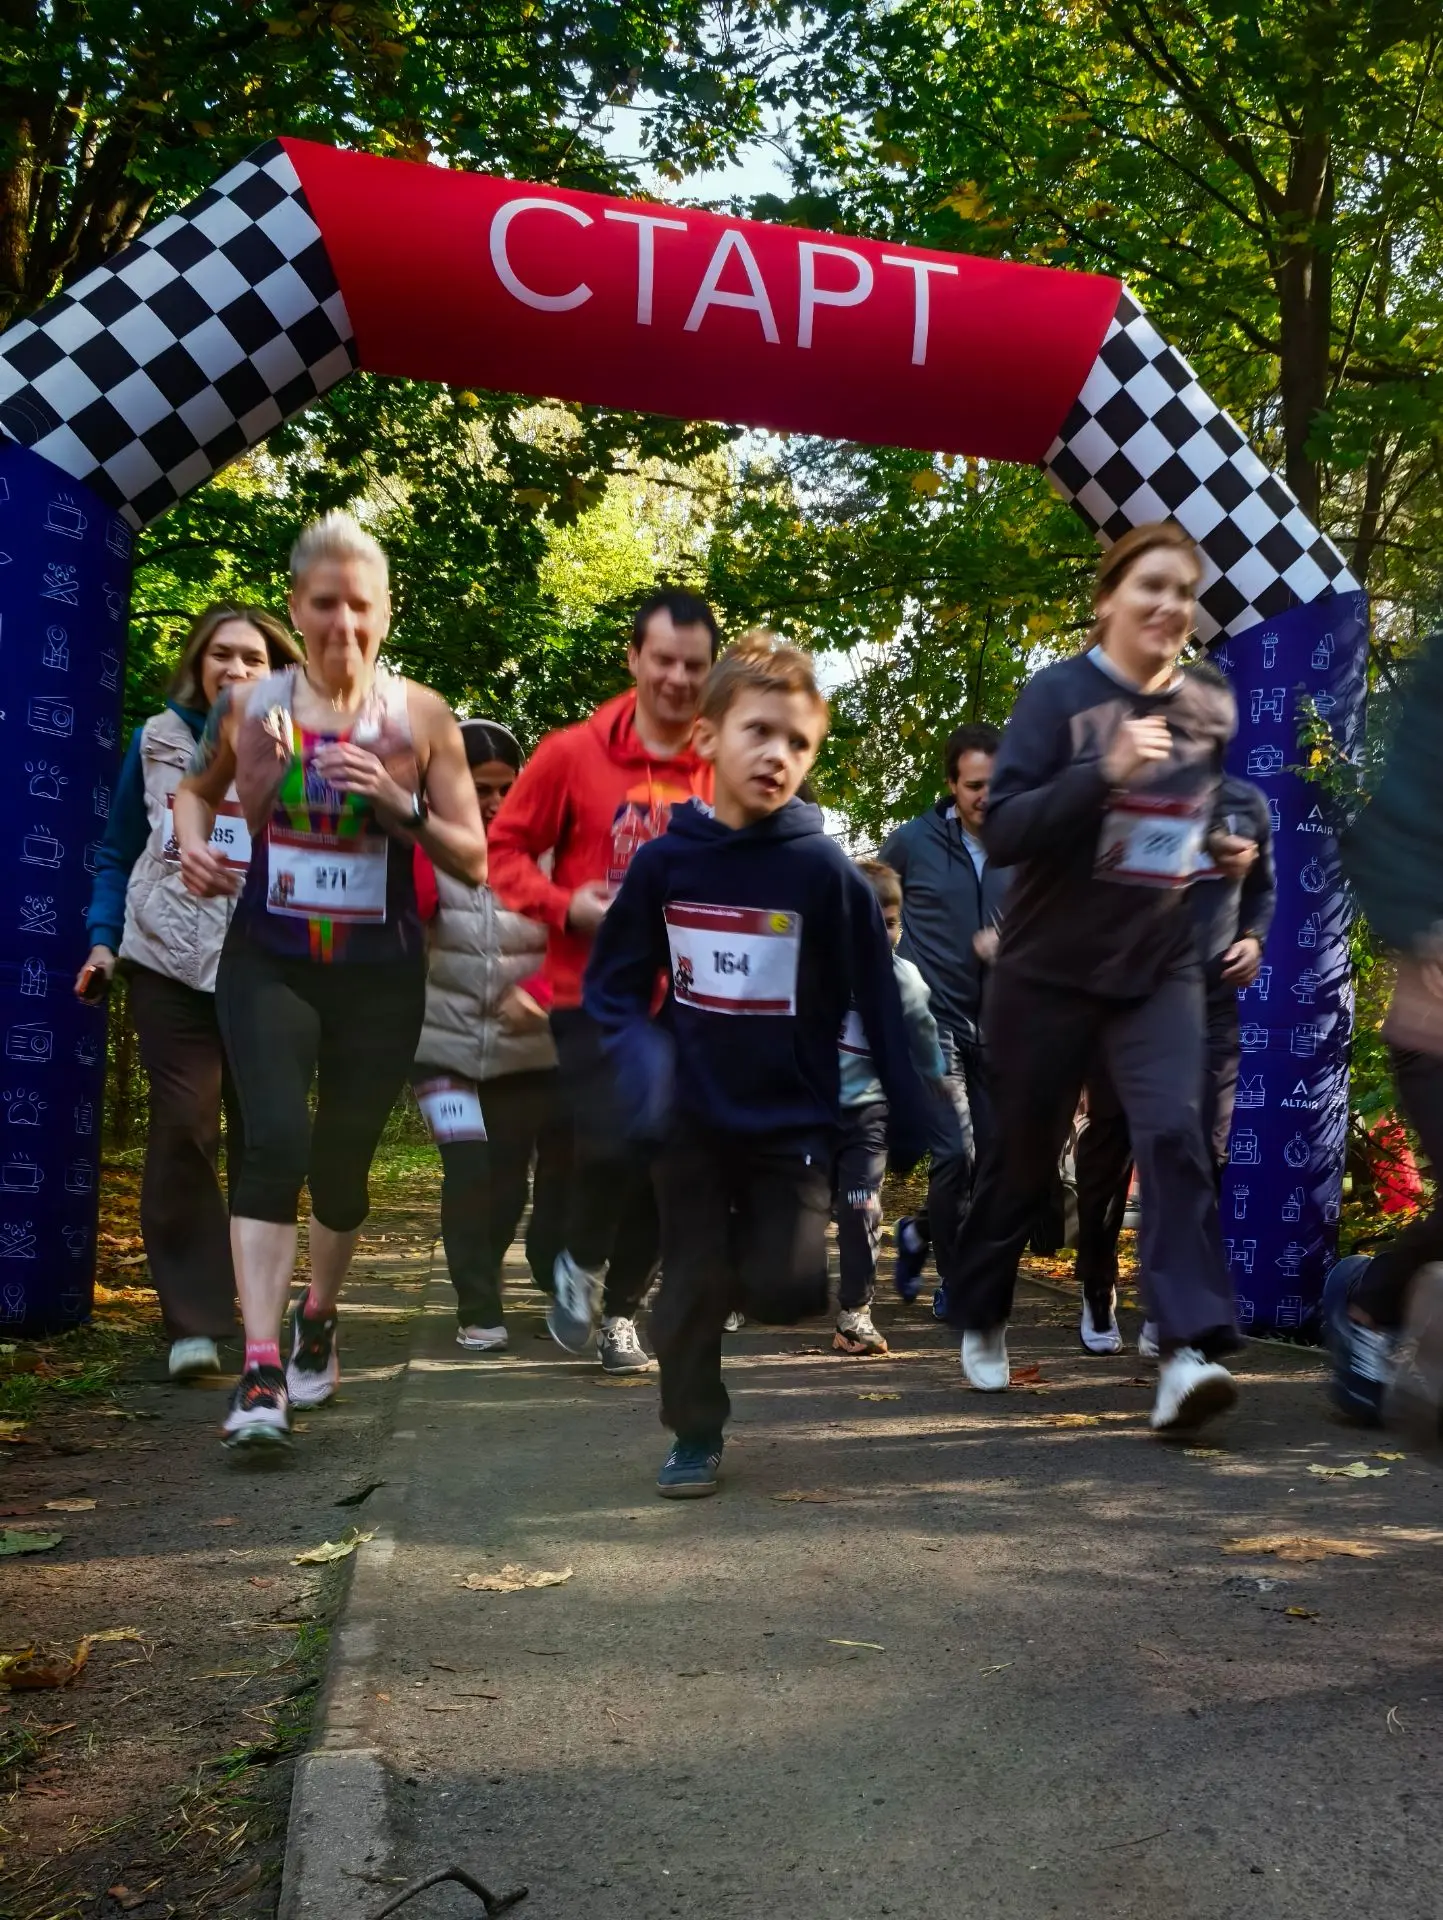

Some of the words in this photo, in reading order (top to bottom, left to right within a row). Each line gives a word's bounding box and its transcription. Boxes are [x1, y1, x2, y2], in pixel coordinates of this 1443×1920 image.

[489, 197, 959, 366] СТАРТ
[1296, 822, 1334, 836] ALTAIR
[713, 950, 750, 977] 164
[1280, 1098, 1319, 1110] ALTAIR
